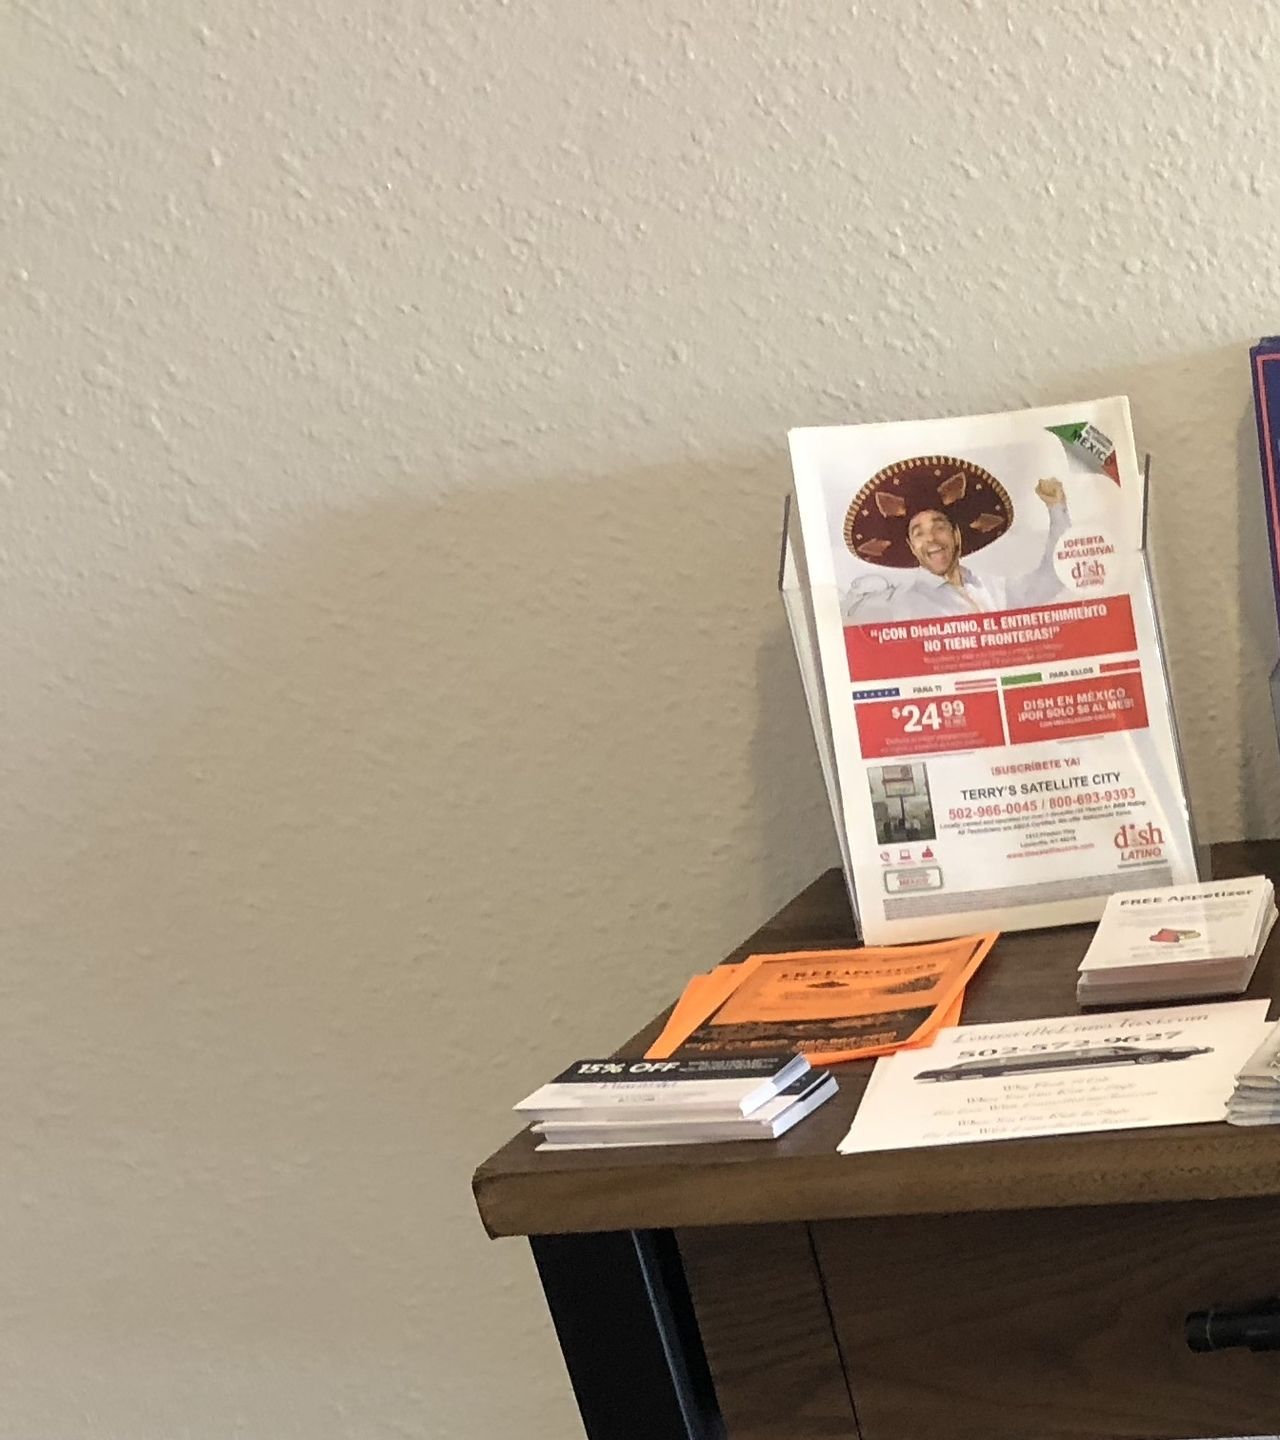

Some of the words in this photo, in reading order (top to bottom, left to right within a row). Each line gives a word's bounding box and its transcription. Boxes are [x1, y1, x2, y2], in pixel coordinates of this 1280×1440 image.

[983, 616, 999, 631] EL
[1001, 604, 1107, 630] ENTRETENIMIENTO
[924, 638, 941, 653] NO
[943, 633, 978, 651] TIENE
[1023, 699, 1054, 711] DISH
[1057, 697, 1073, 708] EN
[960, 783, 1017, 801] TERRY'S
[1020, 775, 1089, 796] SATELLITE
[1092, 772, 1121, 786] CITY
[1114, 822, 1165, 850] dish
[1121, 847, 1162, 862] LATINO
[577, 1063, 624, 1075] 15%
[629, 1062, 680, 1073] OFF
